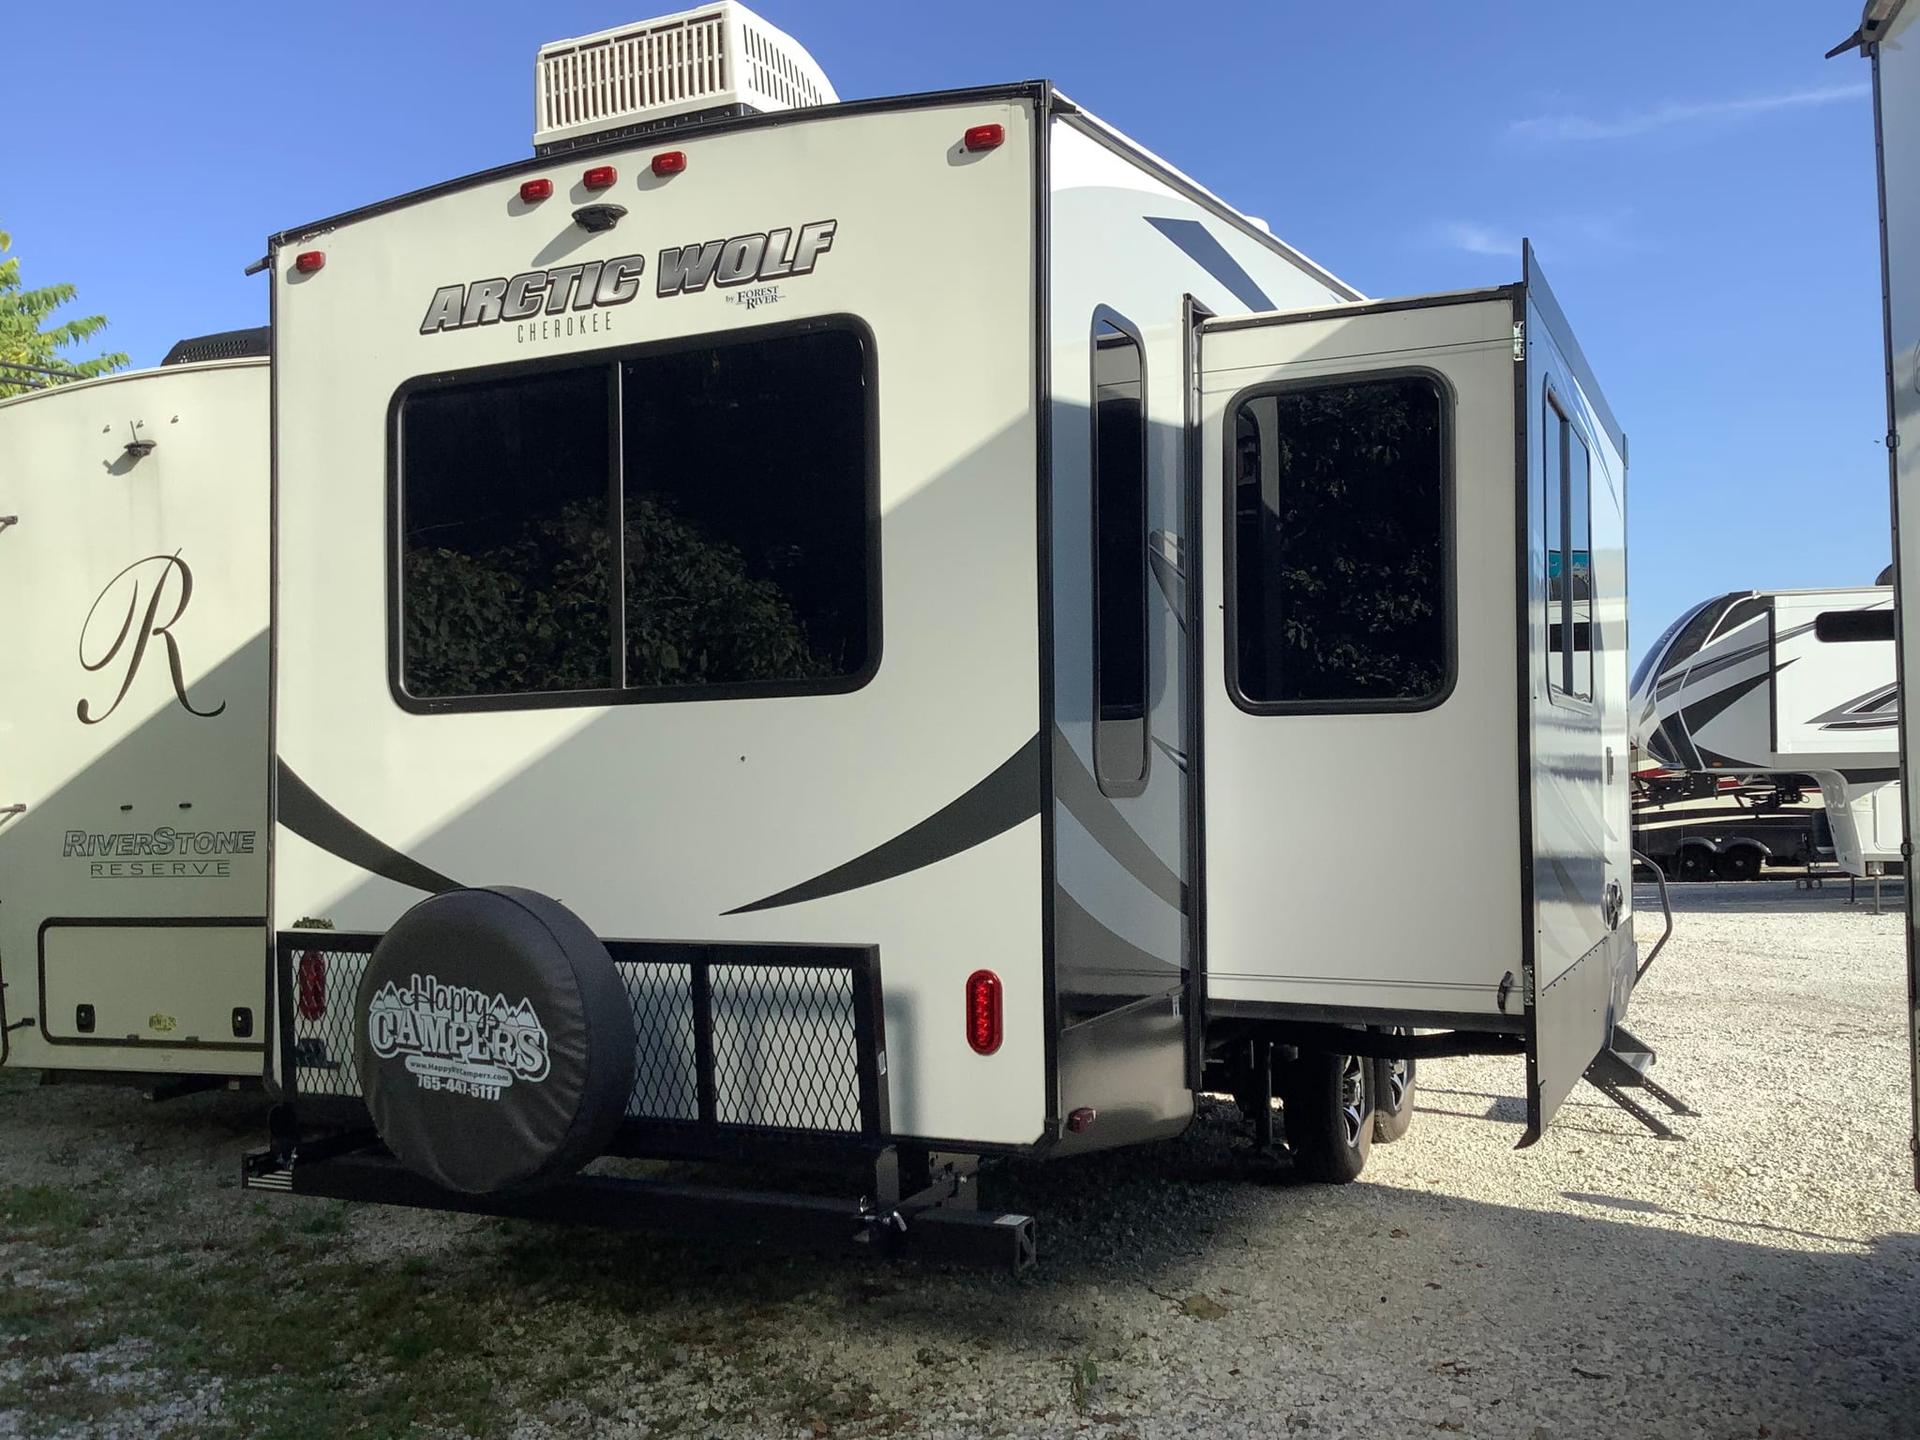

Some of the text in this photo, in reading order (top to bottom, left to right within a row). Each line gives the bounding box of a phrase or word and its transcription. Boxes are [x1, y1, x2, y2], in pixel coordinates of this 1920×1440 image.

[419, 218, 839, 335] ARCTIC WOLF
[737, 285, 779, 303] FOREST
[746, 294, 778, 310] RIVER
[517, 310, 612, 344] CHEROKEE
[90, 861, 231, 876] RESERVE
[400, 975, 489, 1023] Happy
[370, 1009, 549, 1078] CAMPERS
